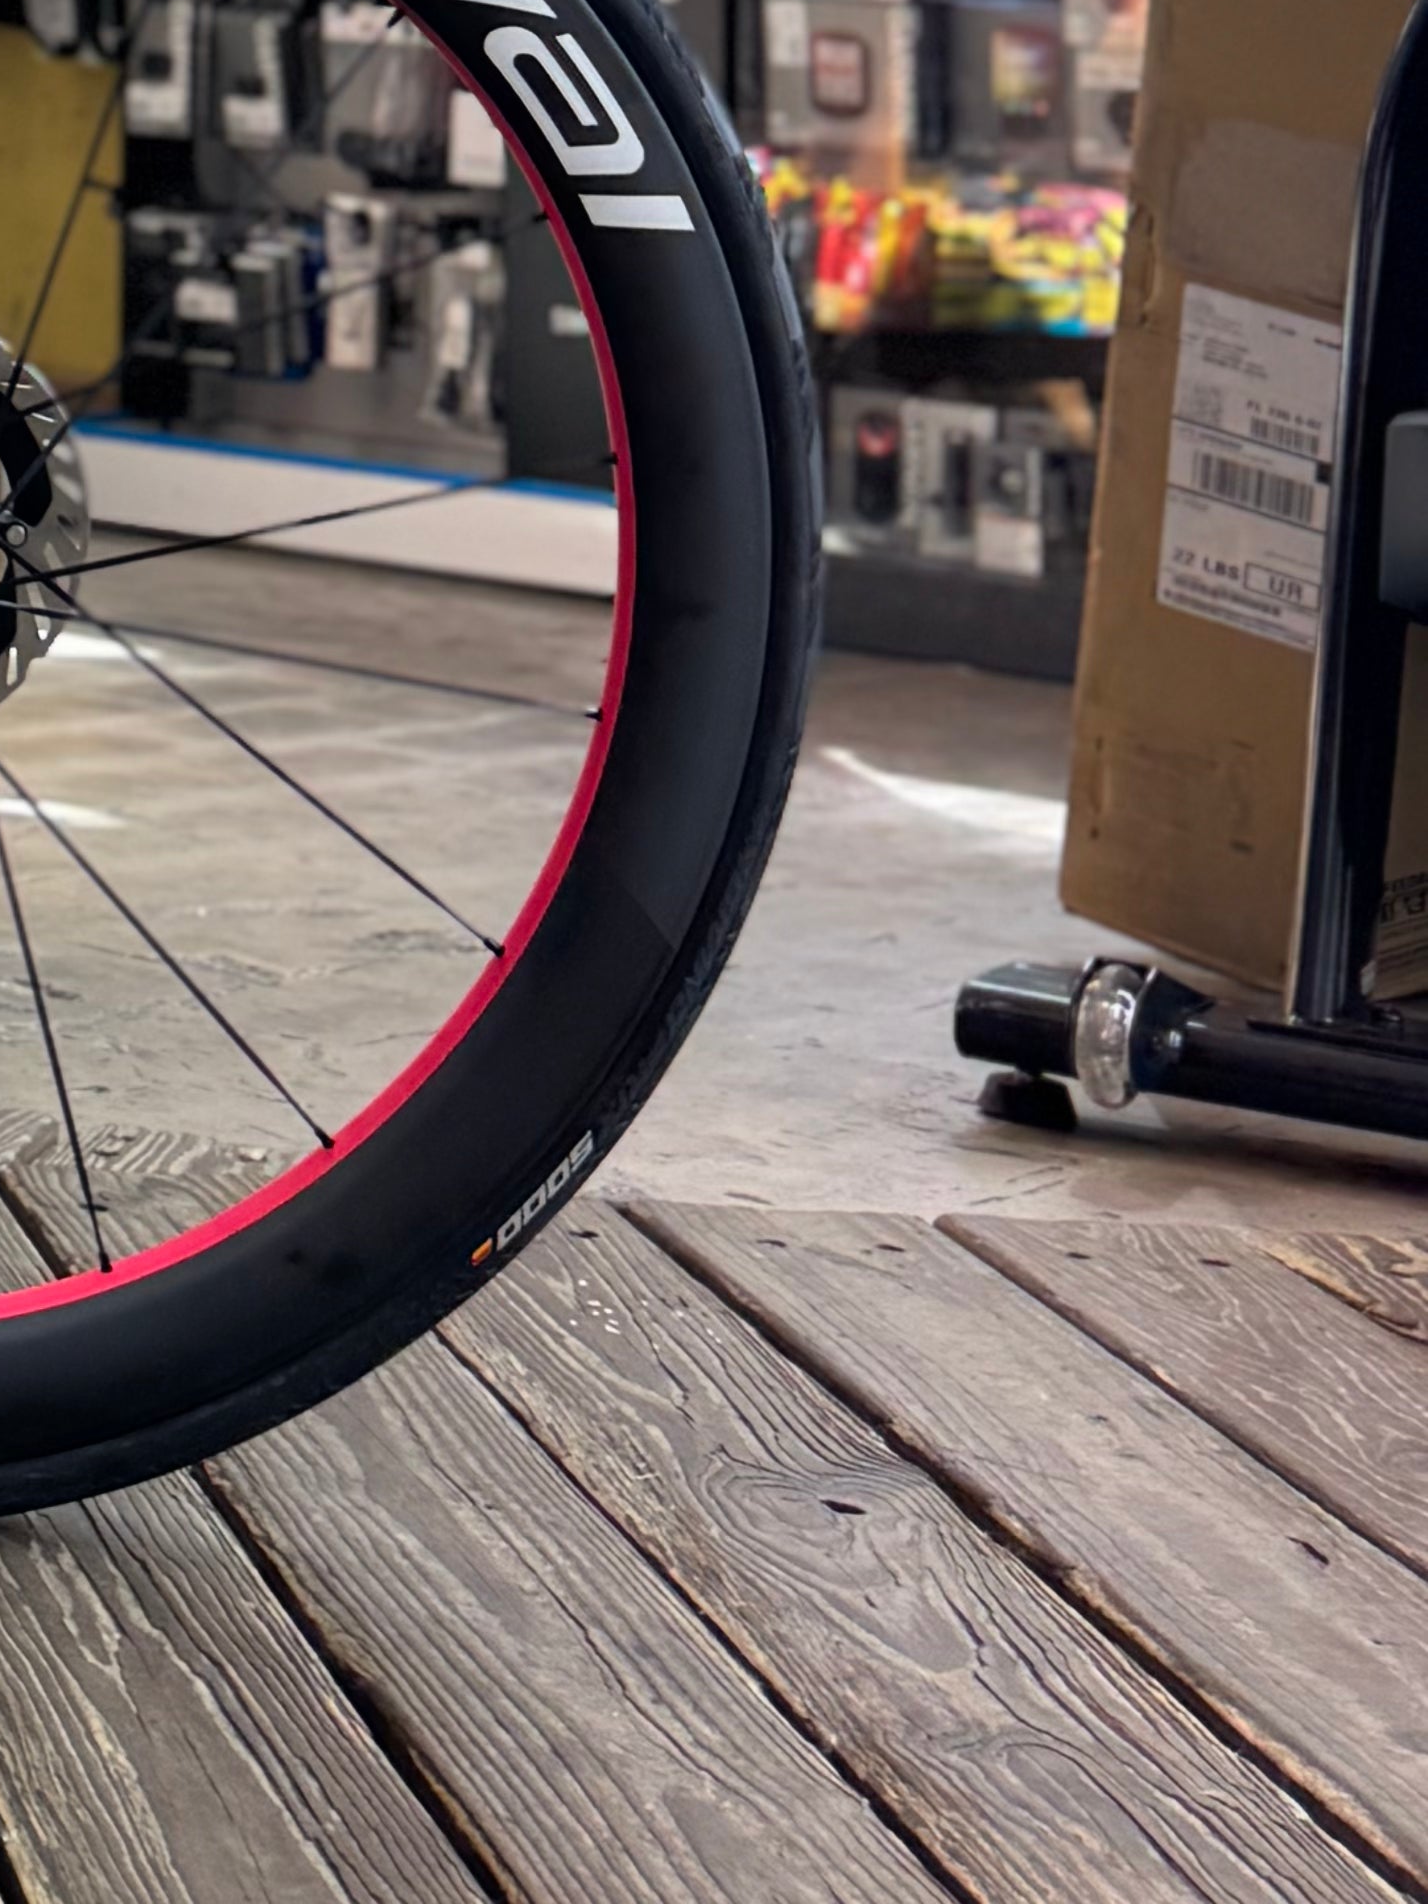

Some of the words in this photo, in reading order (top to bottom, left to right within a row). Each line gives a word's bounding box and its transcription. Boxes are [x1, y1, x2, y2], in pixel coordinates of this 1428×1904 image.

[1172, 546, 1197, 568] 22
[1202, 555, 1240, 581] LBS
[495, 1128, 598, 1252] 5000
